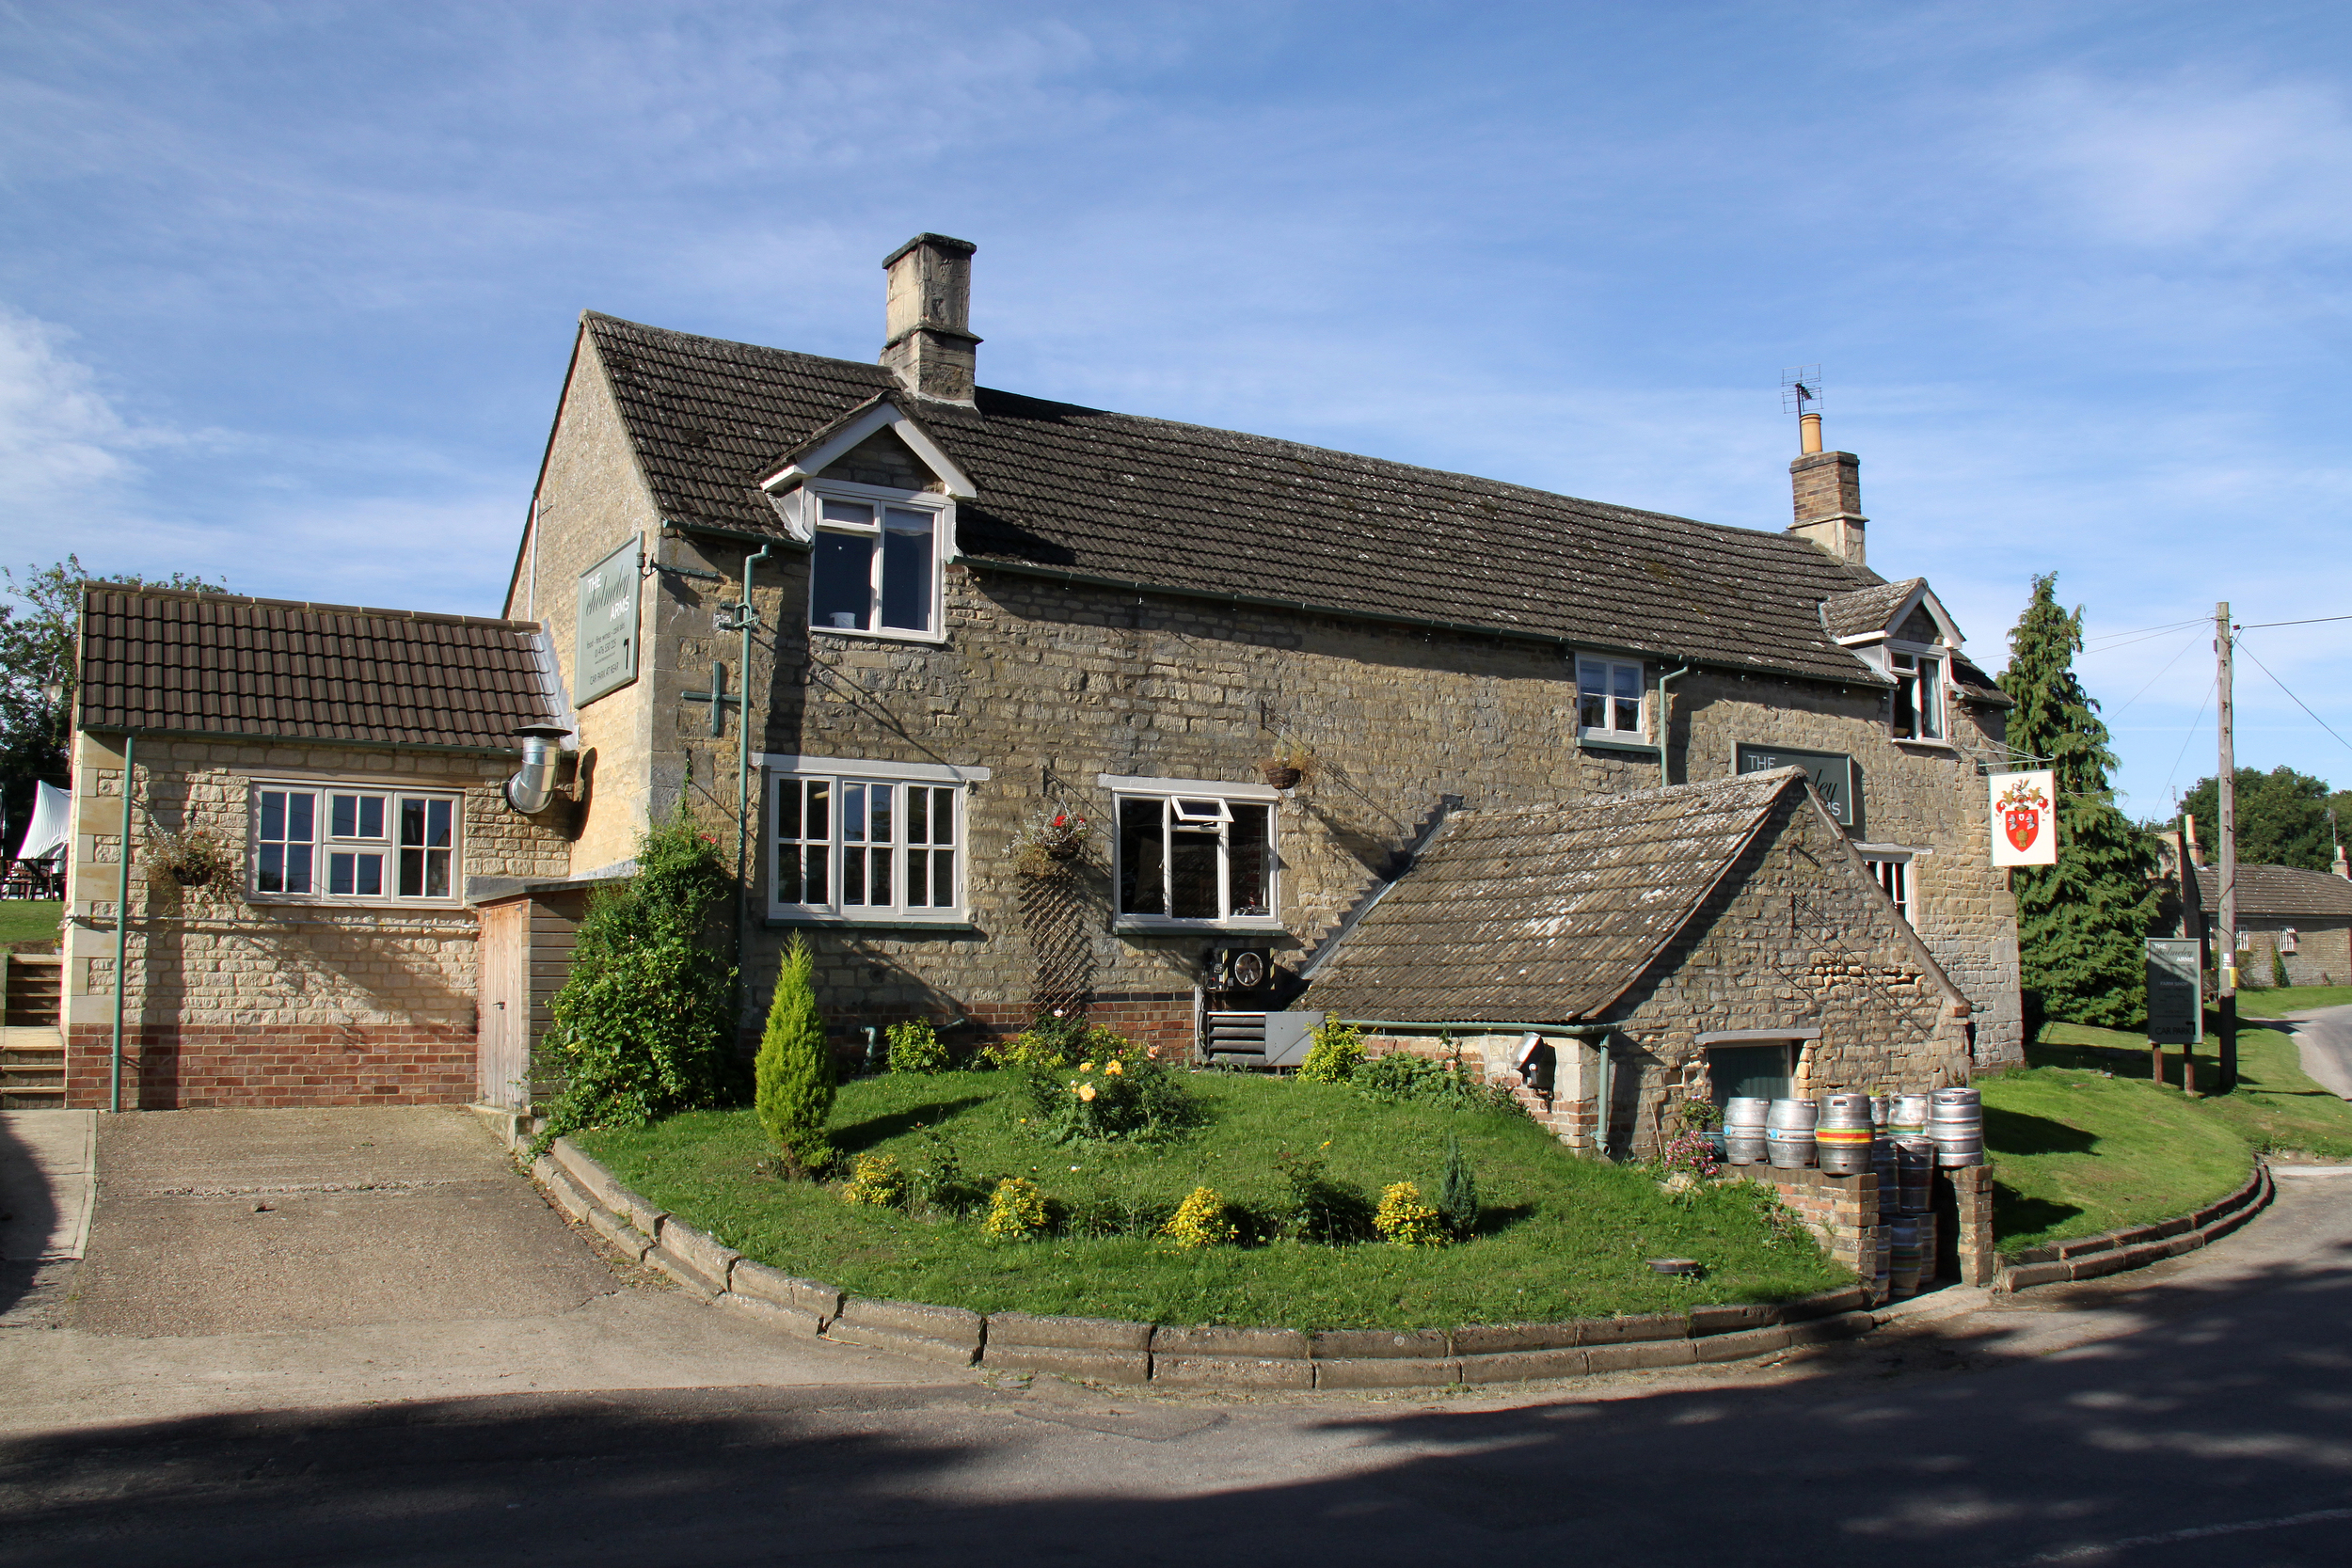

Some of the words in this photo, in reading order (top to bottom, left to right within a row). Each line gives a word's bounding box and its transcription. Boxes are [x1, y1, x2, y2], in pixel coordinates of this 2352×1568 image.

[586, 564, 630, 617] cholmeley
[587, 572, 602, 594] THE
[610, 595, 630, 622] ARMS
[597, 669, 606, 681] PARK
[611, 661, 619, 673] REAR
[1747, 754, 1776, 770] THE
